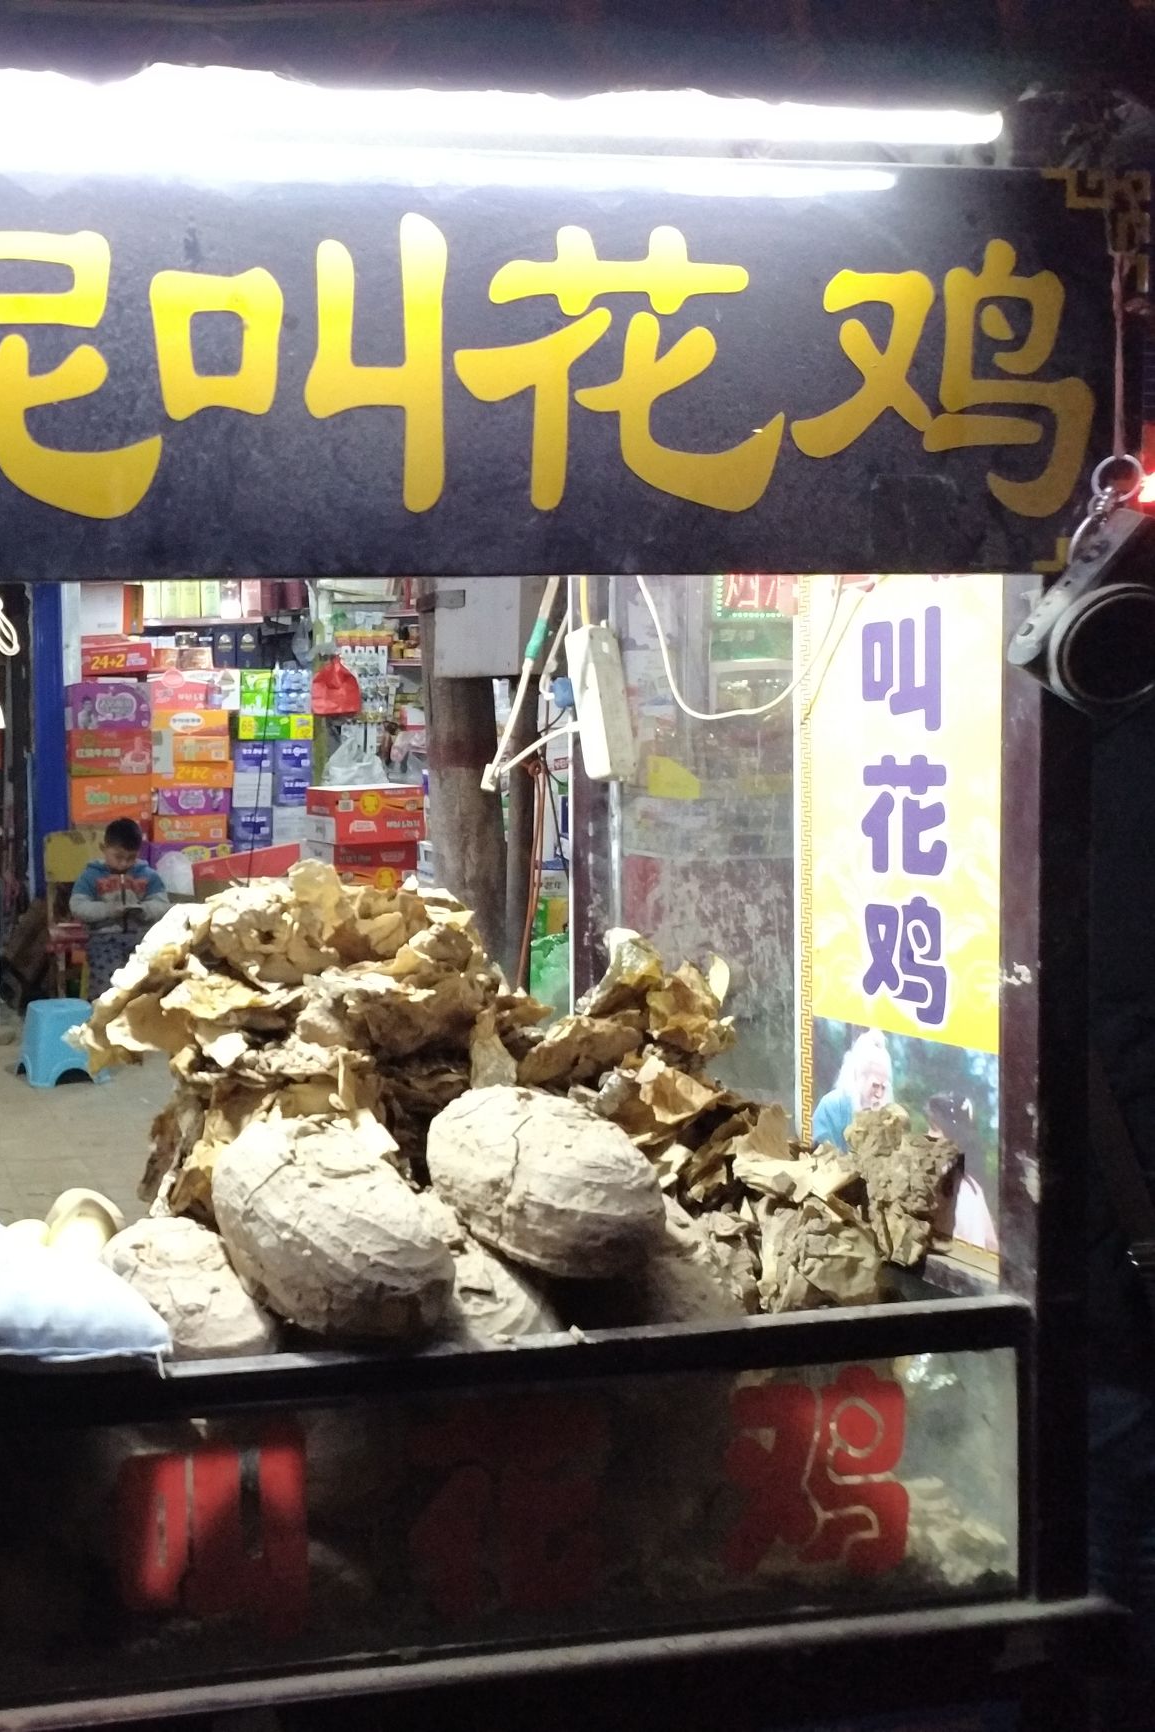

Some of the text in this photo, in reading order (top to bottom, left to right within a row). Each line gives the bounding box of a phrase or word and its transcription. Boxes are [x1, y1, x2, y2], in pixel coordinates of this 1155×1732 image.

[90, 653, 127, 671] 24+2
[860, 604, 948, 1026] 叫花鸡
